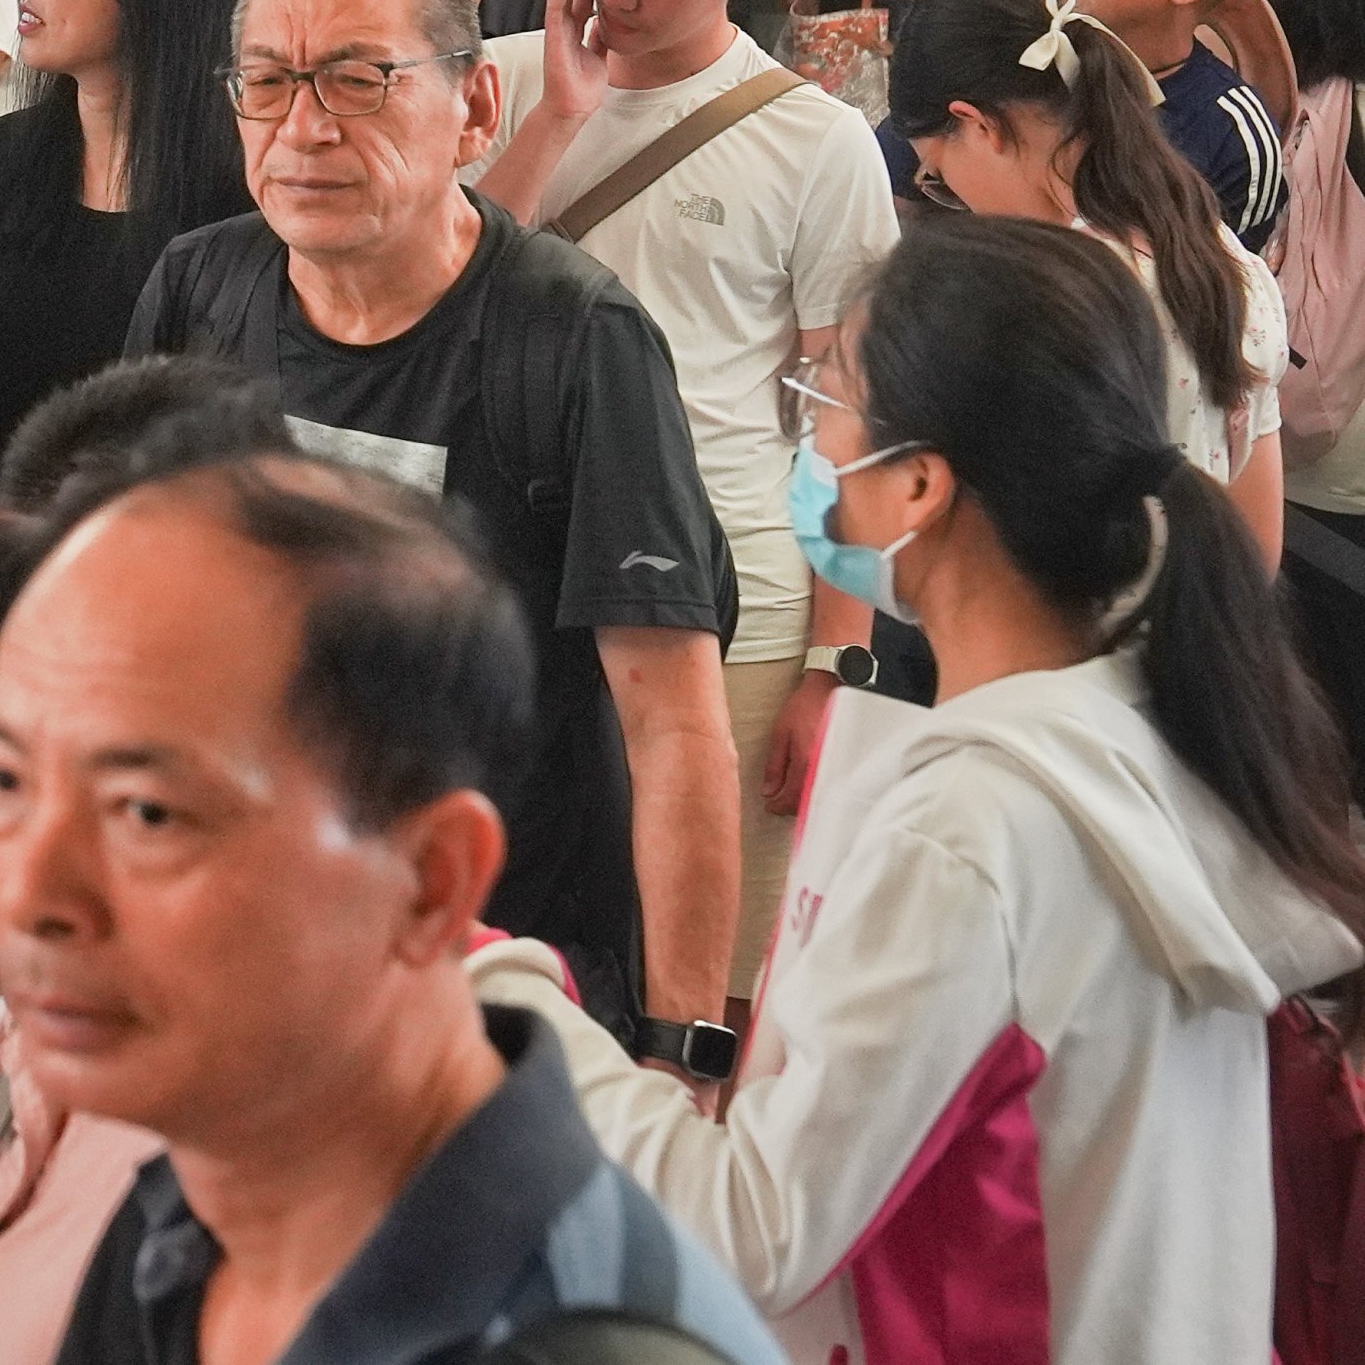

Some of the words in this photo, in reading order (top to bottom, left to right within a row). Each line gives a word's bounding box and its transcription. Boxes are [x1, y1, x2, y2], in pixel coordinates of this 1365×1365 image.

[673, 199, 708, 213] NORTH
[691, 193, 710, 205] THE
[679, 208, 707, 222] FACE
